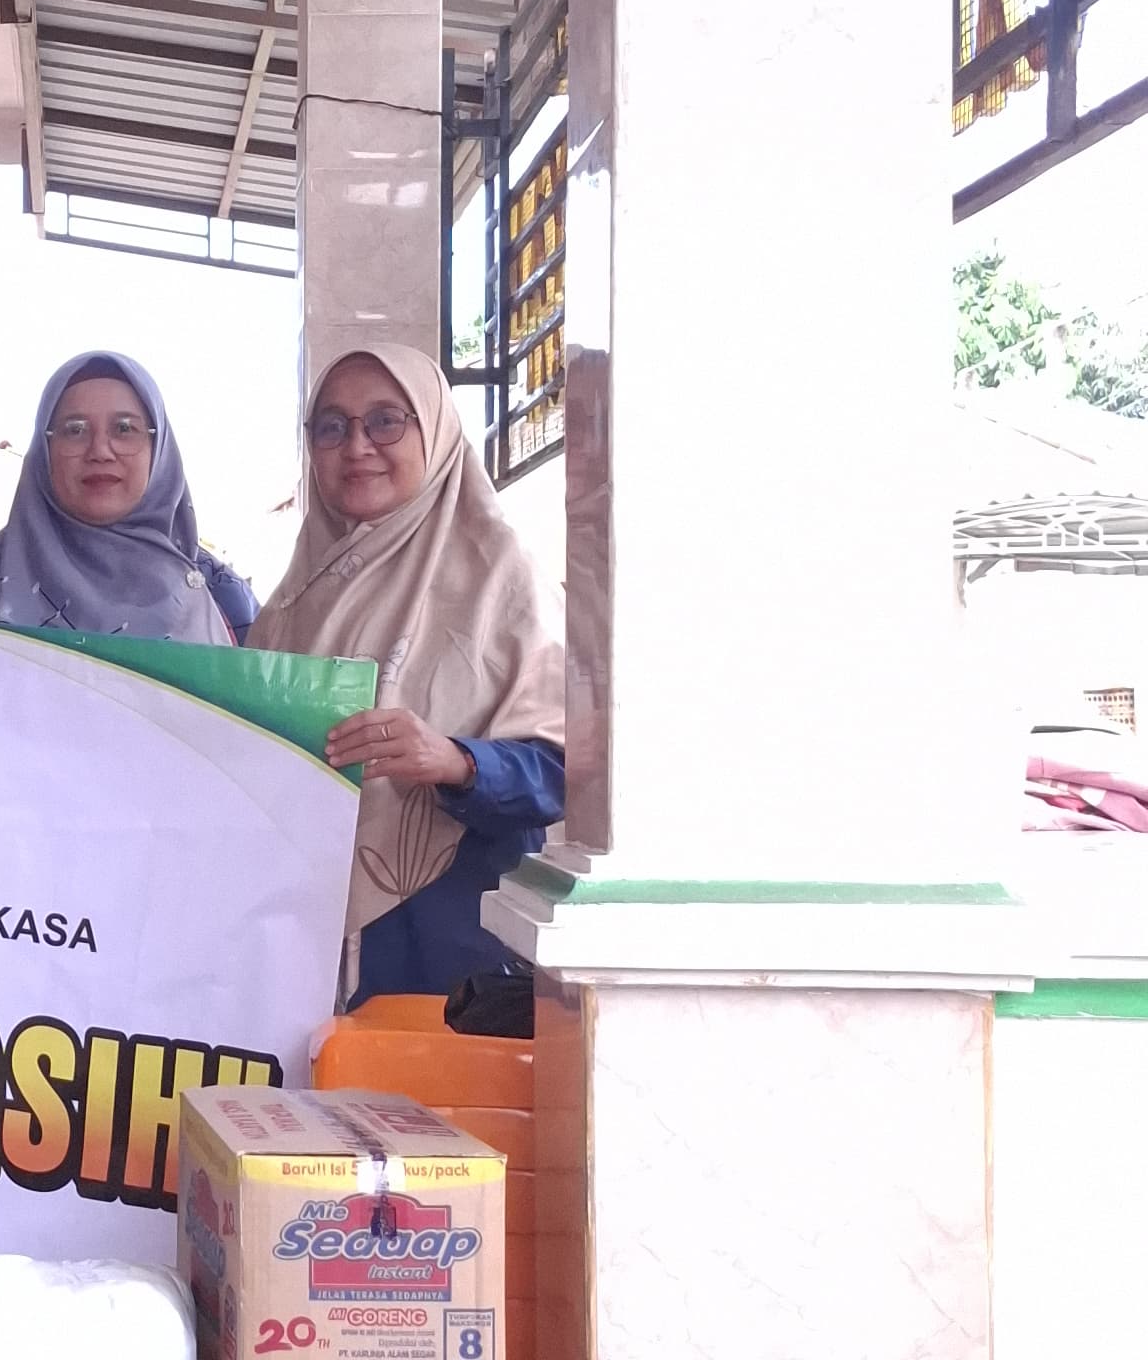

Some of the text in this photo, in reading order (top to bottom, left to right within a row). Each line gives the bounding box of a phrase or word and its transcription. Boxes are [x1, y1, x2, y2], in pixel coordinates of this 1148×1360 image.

[300, 1200, 349, 1222] Mie
[367, 1264, 434, 1282] Instant
[317, 1290, 444, 1301] JELAS TERASA SEDAPNYA
[328, 1307, 427, 1327] MI GORENG
[254, 1316, 317, 1354] 20
[458, 1328, 484, 1360] 8
